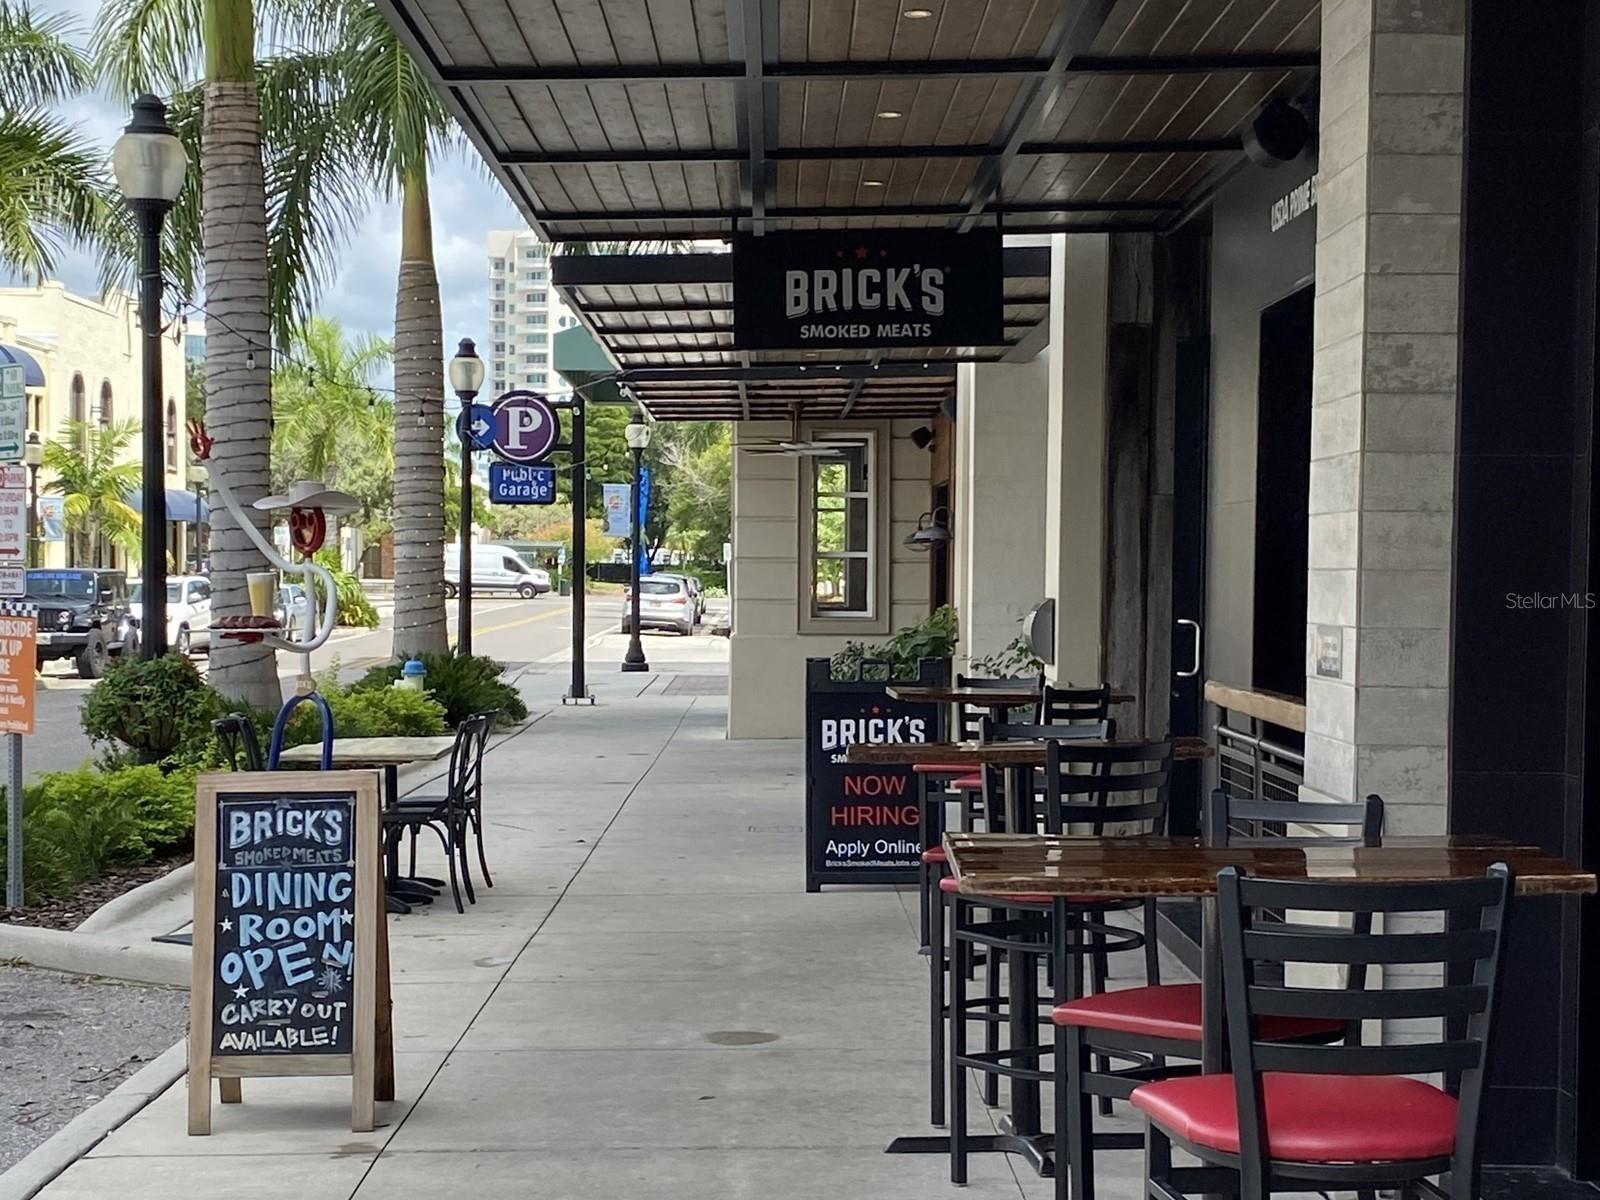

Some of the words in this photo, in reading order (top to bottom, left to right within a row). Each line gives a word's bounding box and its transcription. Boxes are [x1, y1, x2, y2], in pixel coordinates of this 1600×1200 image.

[786, 264, 944, 319] BRICK'S
[800, 324, 871, 339] SMOKED
[877, 323, 932, 338] MEATS
[503, 407, 543, 449] P
[500, 483, 548, 498] Garage
[9, 640, 23, 656] UP
[822, 716, 925, 750] BRICK'S
[844, 775, 907, 796] NOW
[229, 809, 343, 849] BRICK'S
[831, 806, 920, 827] HIRING
[234, 846, 291, 866] SMOKED
[293, 847, 342, 863] MEATS
[825, 840, 870, 857] Apply
[231, 872, 352, 911] DINING
[239, 907, 342, 947] ROOM
[221, 998, 297, 1025] CARRY
[300, 1002, 347, 1021] OUT
[219, 1025, 338, 1050] AVAILABLE!
